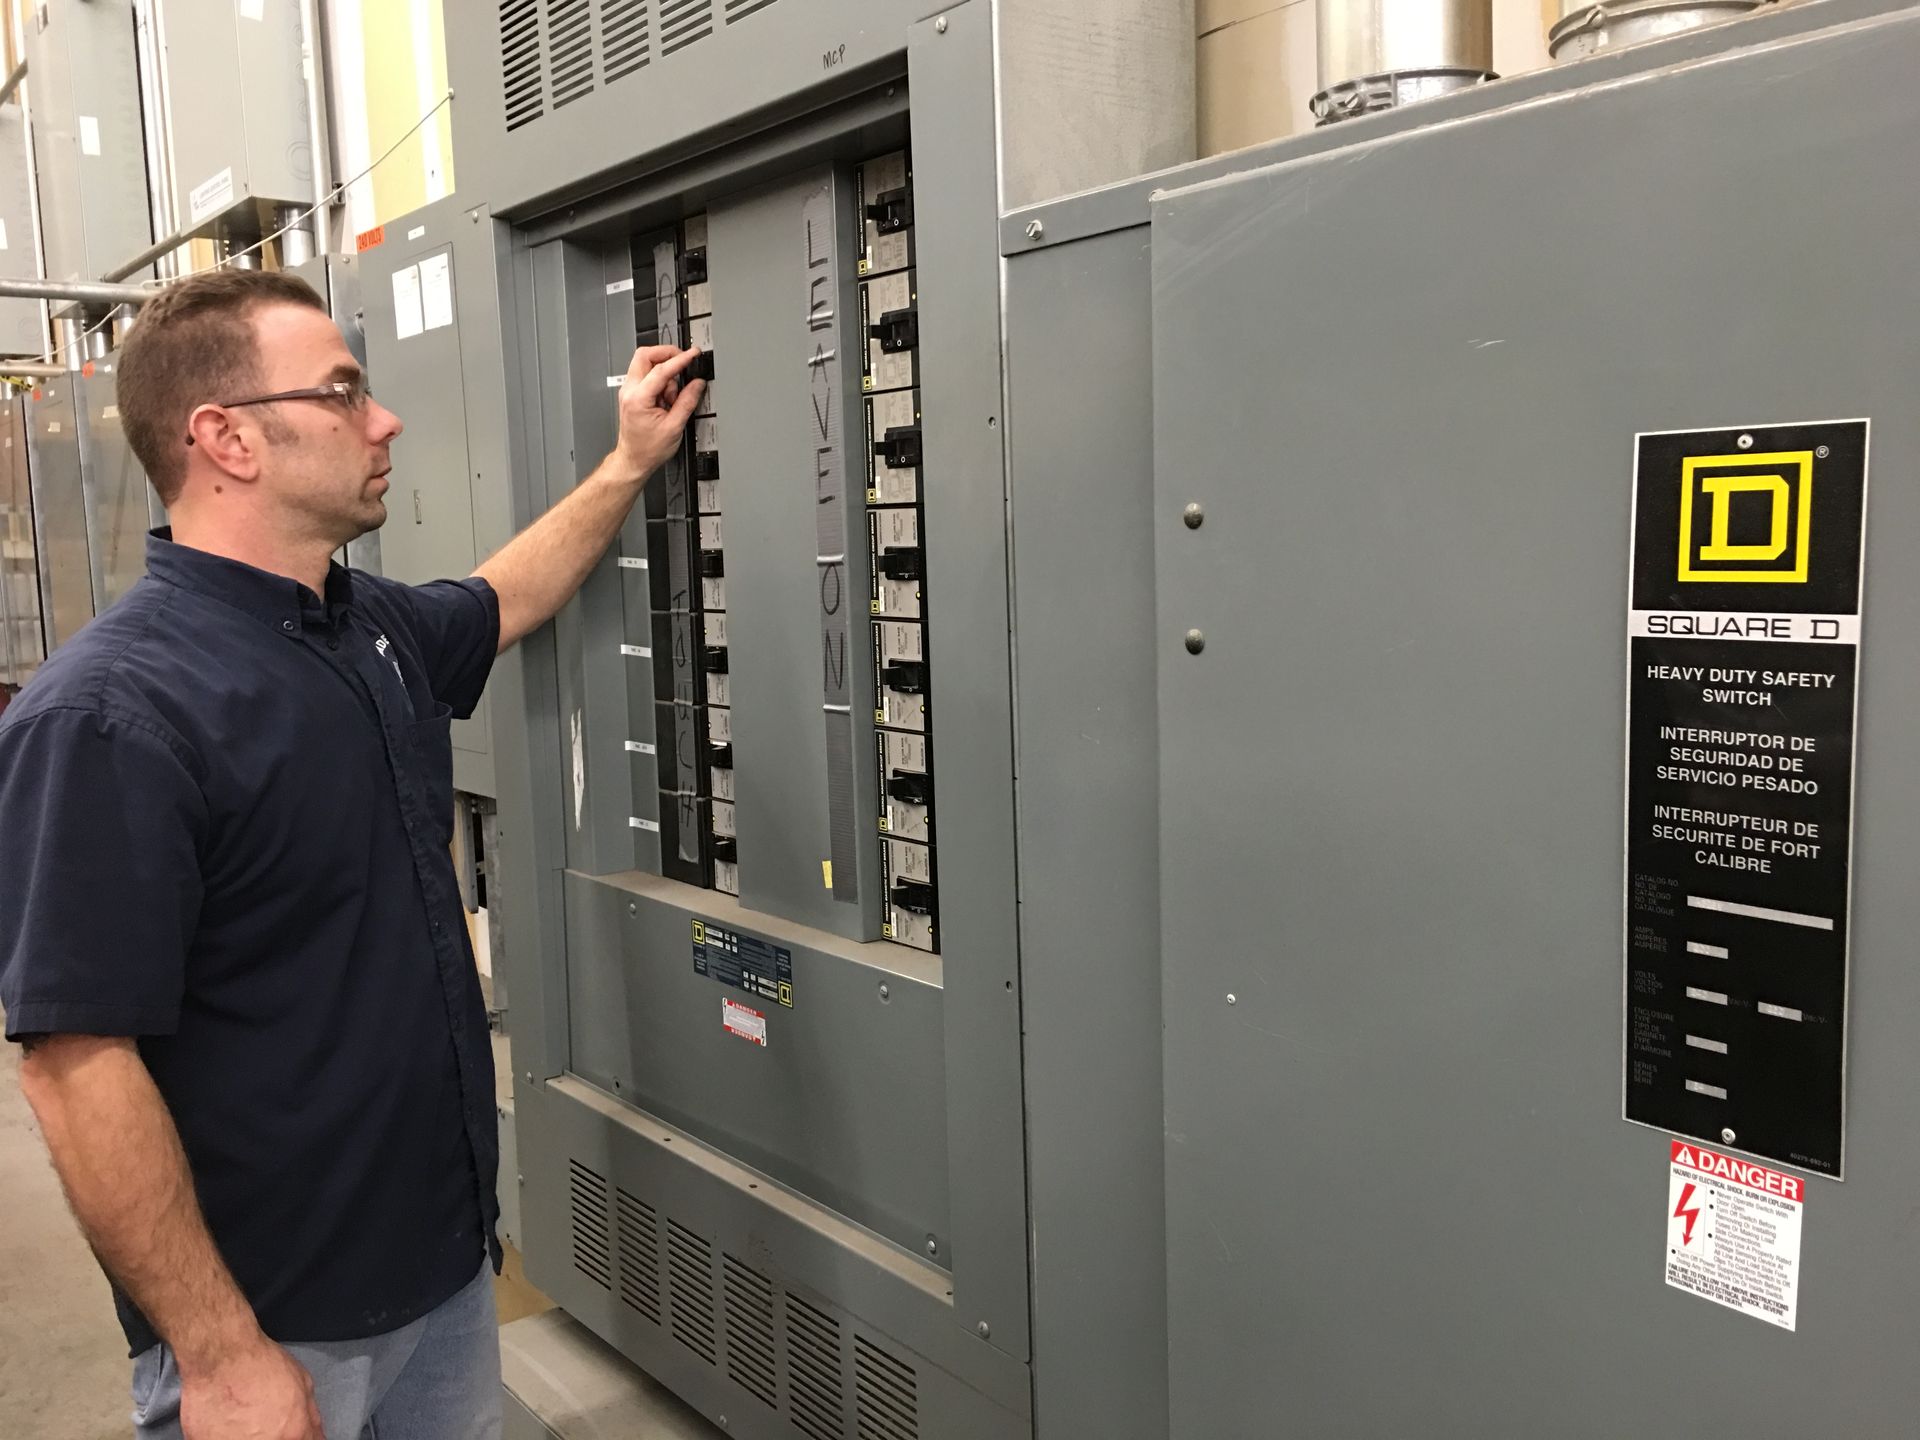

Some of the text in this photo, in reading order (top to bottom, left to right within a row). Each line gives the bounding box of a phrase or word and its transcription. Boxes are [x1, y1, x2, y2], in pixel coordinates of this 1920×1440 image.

[367, 226, 382, 246] VOLTS
[807, 219, 844, 692] LEAVE ON
[1647, 615, 1839, 639] SQUARE D
[1647, 665, 1835, 688] HEAVY DUTY SAFETY
[1702, 688, 1772, 706] SWITCH
[1661, 726, 1816, 752] INTERRUPTOR DE
[1670, 747, 1803, 772] SEGURIDAD DE
[1656, 765, 1818, 795] SERVICIO PESADO
[1654, 805, 1819, 838] INTERRUPTEUR DE
[1652, 824, 1821, 859] SECURITE DE FORT
[1695, 851, 1771, 874] CALIBRE
[1698, 1150, 1798, 1199] DANGER
[1672, 1166, 1691, 1179] HAZARD
[1691, 1173, 1698, 1181] OF
[1698, 1175, 1725, 1190] ELECTRICAL
[1745, 1190, 1759, 1201] BURN
[1767, 1197, 1795, 1212] EXPLOSION
[1716, 1190, 1731, 1201] Never
[1758, 1219, 1776, 1231] Before
[1714, 1234, 1733, 1246] Always
[1751, 1246, 1774, 1260] Properly
[1667, 1275, 1694, 1290] PERSONAL
[1695, 1285, 1714, 1297] INJURY
[1715, 1292, 1723, 1300] OR
[1668, 1262, 1788, 1312] FAILURE TO FOLLOW THE ABOVE INSTRUCTIONS
[1668, 1268, 1679, 1278] WILL
[1681, 1273, 1700, 1286] RESULT
[1709, 1283, 1739, 1300] ELECTRICAL
[1763, 1303, 1783, 1316] SEVERE
